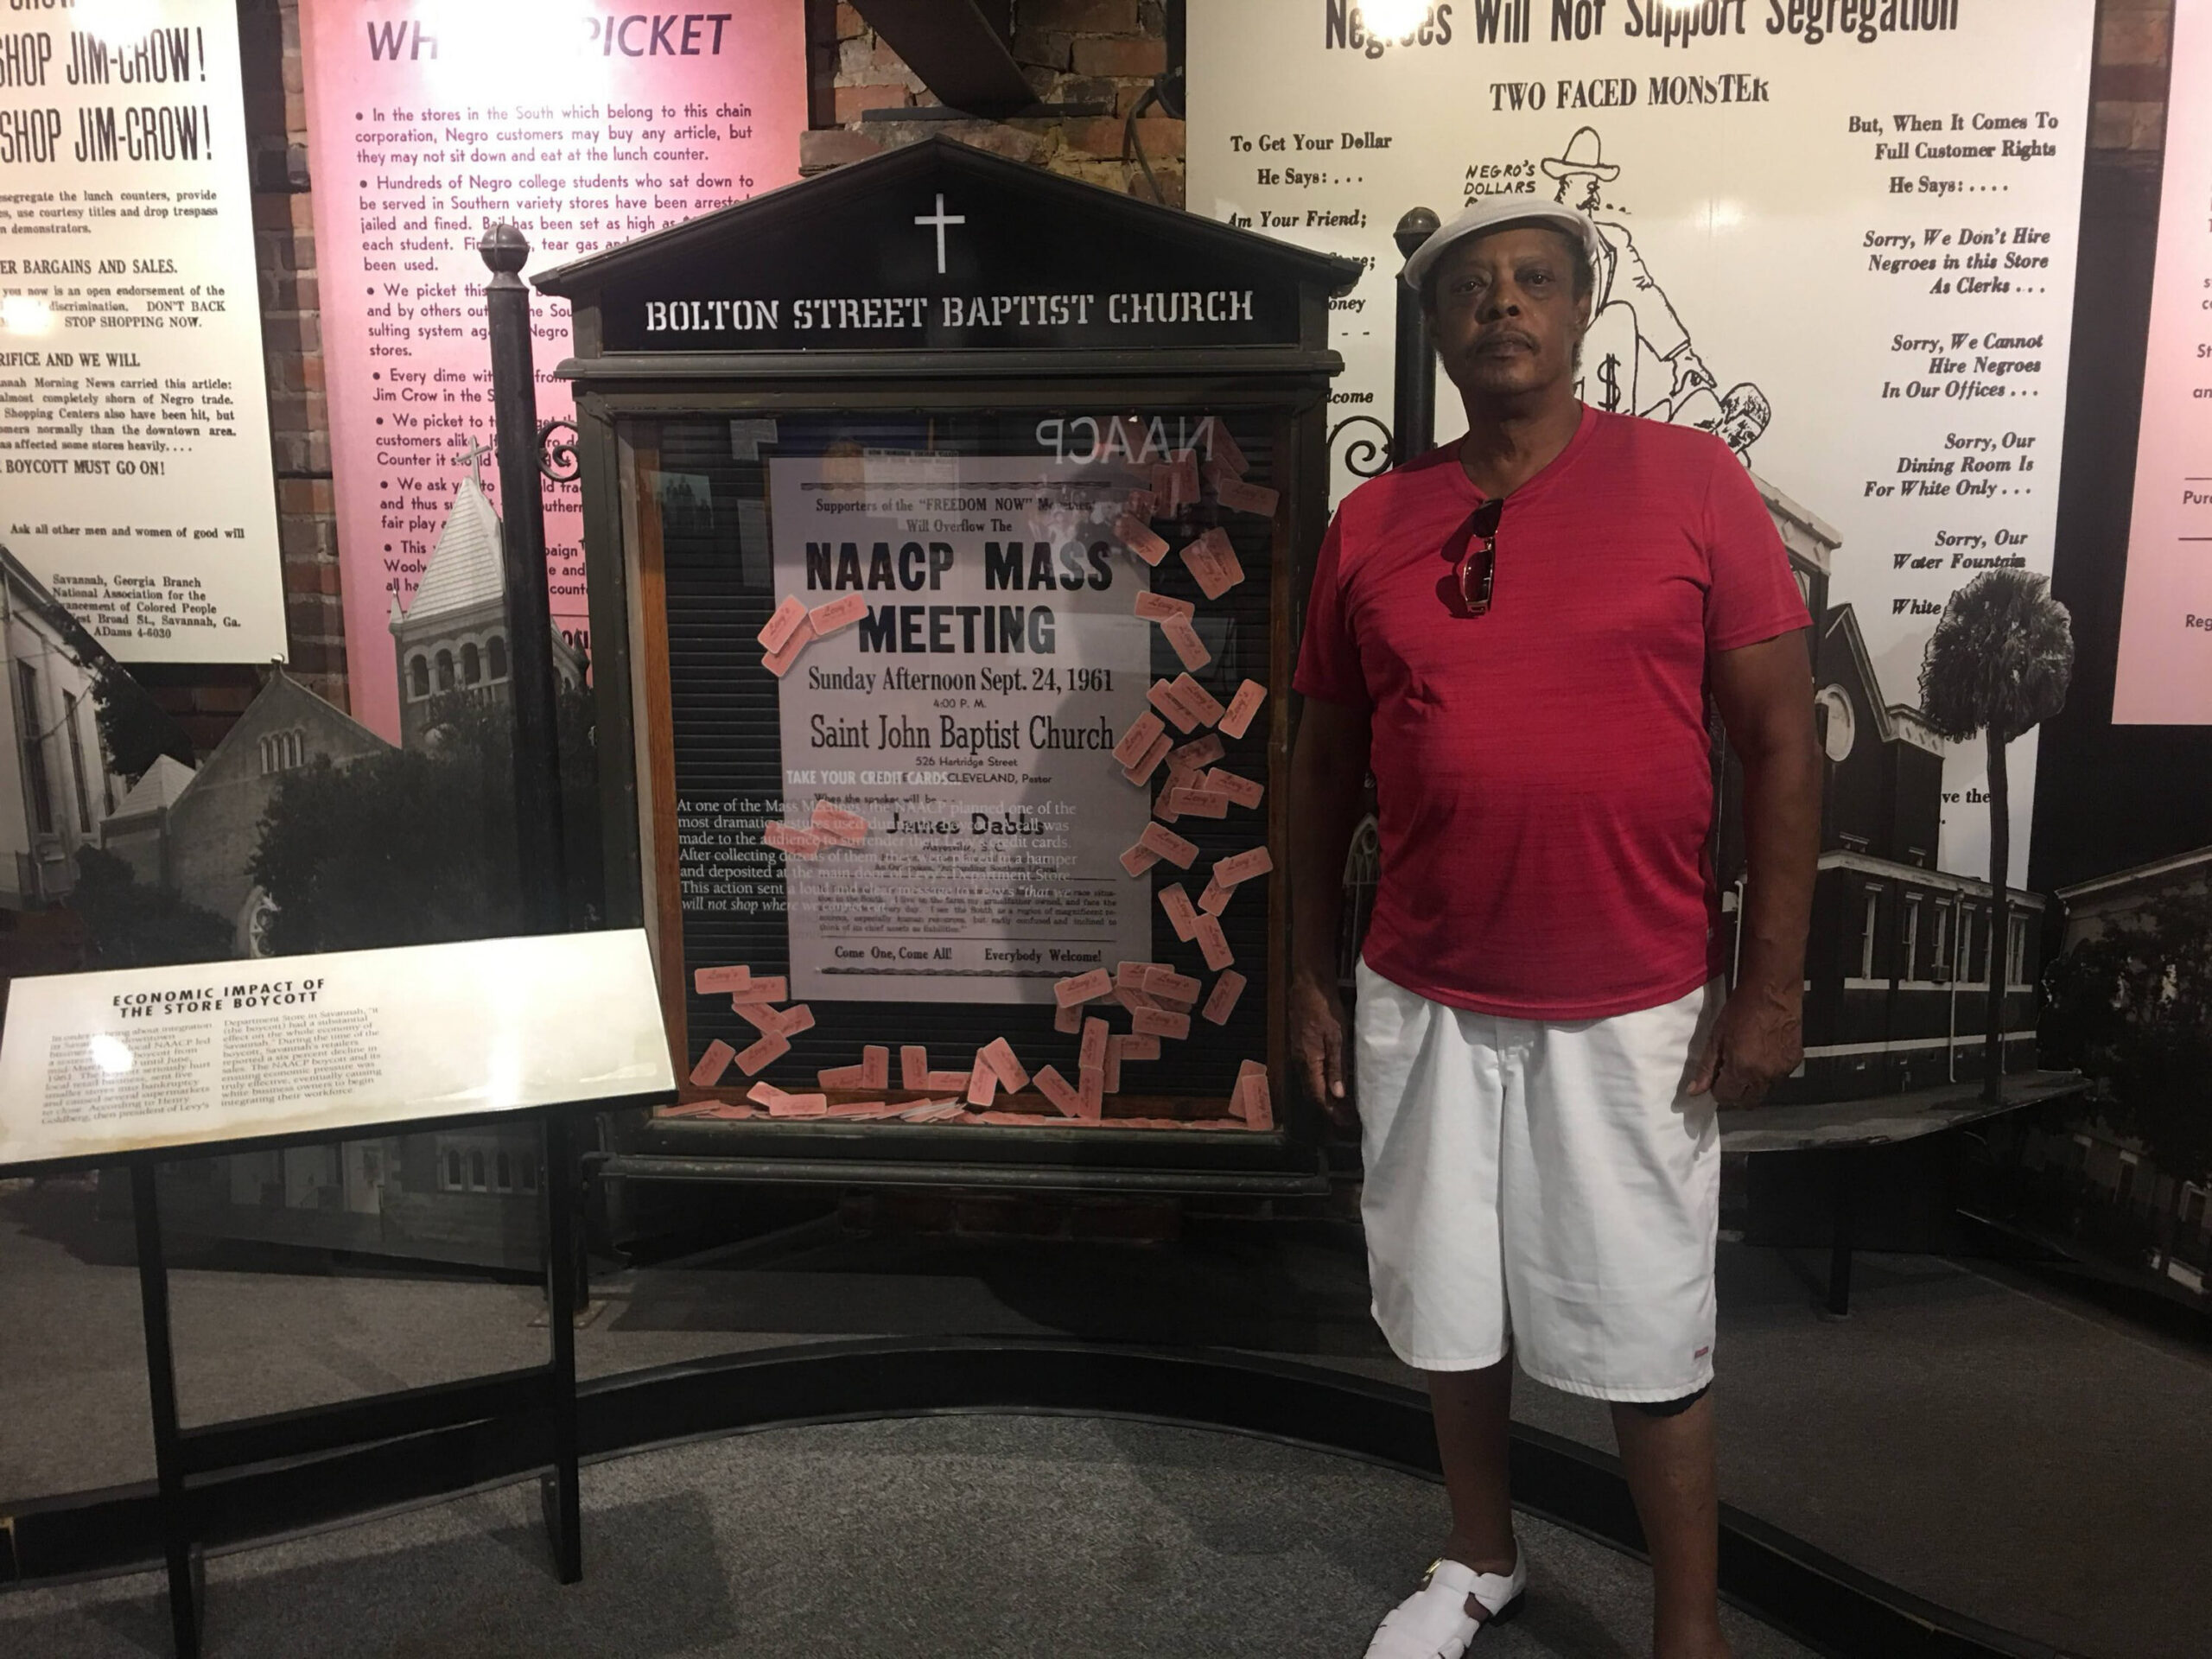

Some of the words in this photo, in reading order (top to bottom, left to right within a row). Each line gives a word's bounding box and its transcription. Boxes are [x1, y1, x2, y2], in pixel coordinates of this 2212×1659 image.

[1474, 0, 1530, 44] Will
[1550, 0, 1606, 42] Not
[1624, 0, 1745, 48] Support
[1765, 0, 1959, 45] Segregation
[1490, 81, 1546, 111] TWO
[1556, 78, 1637, 109] FACED
[0, 108, 61, 163] SHOP
[74, 105, 212, 162] JIM-CROW!
[1848, 116, 1884, 137] But,
[1892, 114, 1942, 132] When
[1950, 113, 1964, 131] It
[1972, 112, 2028, 130] Comes
[2035, 111, 2059, 130] To
[354, 128, 437, 146] corporation,
[445, 127, 488, 146] Negro
[496, 128, 564, 142] customers
[571, 130, 600, 144] may
[607, 124, 633, 143] buy
[641, 130, 666, 143] any
[673, 124, 721, 142] article,
[729, 124, 753, 139] but
[1230, 135, 1252, 153] To
[1258, 134, 1287, 152] Get
[1293, 133, 1334, 151] Your
[1340, 131, 1393, 150] Dollar
[1874, 142, 1910, 161] Full
[1915, 142, 1996, 159] Customer
[2001, 139, 2056, 162] Rights
[1465, 159, 1535, 180] NEGRO'S
[377, 175, 442, 190] Hundreds
[448, 174, 463, 189] of
[469, 175, 512, 193] Negro
[518, 174, 566, 193] college
[573, 173, 629, 188] students
[635, 172, 663, 188] who
[669, 175, 690, 188] sat
[696, 172, 733, 188] down
[739, 175, 754, 188] to
[1463, 180, 1536, 195] DOLLARS
[59, 190, 77, 201] the
[83, 190, 113, 201] lunch
[120, 190, 170, 202] counters,
[176, 189, 217, 203] provide
[1260, 210, 1300, 228] Your
[1306, 208, 1367, 229] Friend;
[1862, 230, 1916, 251] Sorry,
[1923, 228, 1952, 246] We
[1957, 227, 2006, 245] Don't
[2012, 226, 2050, 245] Hire
[22, 259, 92, 275] BARGAINS
[98, 259, 126, 274] AND
[132, 258, 178, 274] SALES.
[363, 256, 397, 271] been
[404, 256, 439, 271] used.
[1868, 254, 1937, 275] Negroes
[1942, 253, 1961, 270] in
[1966, 252, 1998, 270] this
[2004, 251, 2050, 270] Store
[645, 300, 779, 331] BOLTON
[793, 297, 928, 329] STREET
[942, 294, 1094, 327] BAPTIST
[1109, 290, 1254, 323] CHURCH
[65, 316, 97, 327] STOP
[99, 316, 164, 327] SHOPPING
[168, 316, 202, 327] NOW.
[1891, 334, 1944, 354] Sorry,
[1950, 333, 1979, 350] We
[1983, 332, 2044, 350] Cannot
[46, 353, 74, 367] AND
[79, 353, 101, 367] WE
[105, 353, 141, 367] WILL
[1928, 357, 1967, 374] Hire
[1973, 356, 2042, 377] Negroes
[1944, 432, 1997, 453] Sorry,
[2001, 431, 2036, 448] Our
[5, 459, 68, 474] BOYCOTT
[73, 460, 111, 475] MUST
[116, 460, 137, 475] GO
[139, 460, 165, 476] ON!
[1896, 457, 1955, 476] Dining
[1960, 456, 2012, 473] Room
[2018, 454, 2034, 472] Is
[815, 498, 877, 515] Supporters
[881, 498, 893, 512] of
[895, 498, 913, 512] the
[906, 518, 930, 533] Will
[933, 518, 986, 533] Overflow
[990, 518, 1013, 532] The
[1935, 530, 1986, 550] Sorry,
[1994, 529, 2029, 546] Our
[805, 541, 955, 591] NAACP
[984, 540, 1114, 591] MASS
[53, 574, 108, 588] Savannah,
[113, 575, 156, 588] Georgia
[162, 575, 201, 588] Branch
[93, 628, 132, 639] ADams
[137, 627, 172, 639] 4-6030
[859, 605, 1056, 654] MEETING
[808, 665, 876, 696] Sunday
[882, 666, 976, 691] Afternoon
[981, 667, 1027, 696] Sept.
[1032, 667, 1062, 695] 24,
[1067, 668, 1115, 692] 1961
[932, 697, 957, 709] 4:00
[810, 714, 870, 749] Saint
[877, 714, 931, 751] John
[938, 714, 1021, 754] Baptist
[1029, 715, 1116, 751] Church
[915, 756, 936, 766] 526
[939, 756, 984, 769] Hartridge
[987, 756, 1018, 767] Street
[786, 770, 817, 785] TAKE
[820, 770, 856, 785] YOUR
[1022, 773, 1053, 785] Pastor
[677, 798, 692, 812] At
[695, 802, 720, 812] one
[723, 798, 738, 812] of
[740, 798, 761, 812] the
[834, 945, 865, 959] Come
[870, 946, 896, 962] One,
[898, 946, 929, 960] Come
[932, 947, 952, 960] All!
[985, 947, 1044, 966] Everybody
[1048, 949, 1102, 963] Welcome!
[112, 988, 214, 1007] ECONOMIC
[224, 981, 294, 997] IMPACT
[302, 978, 324, 990] OF
[121, 1006, 154, 1018] THE
[164, 999, 223, 1015] STORE
[232, 991, 318, 1009] BOYCOTT
